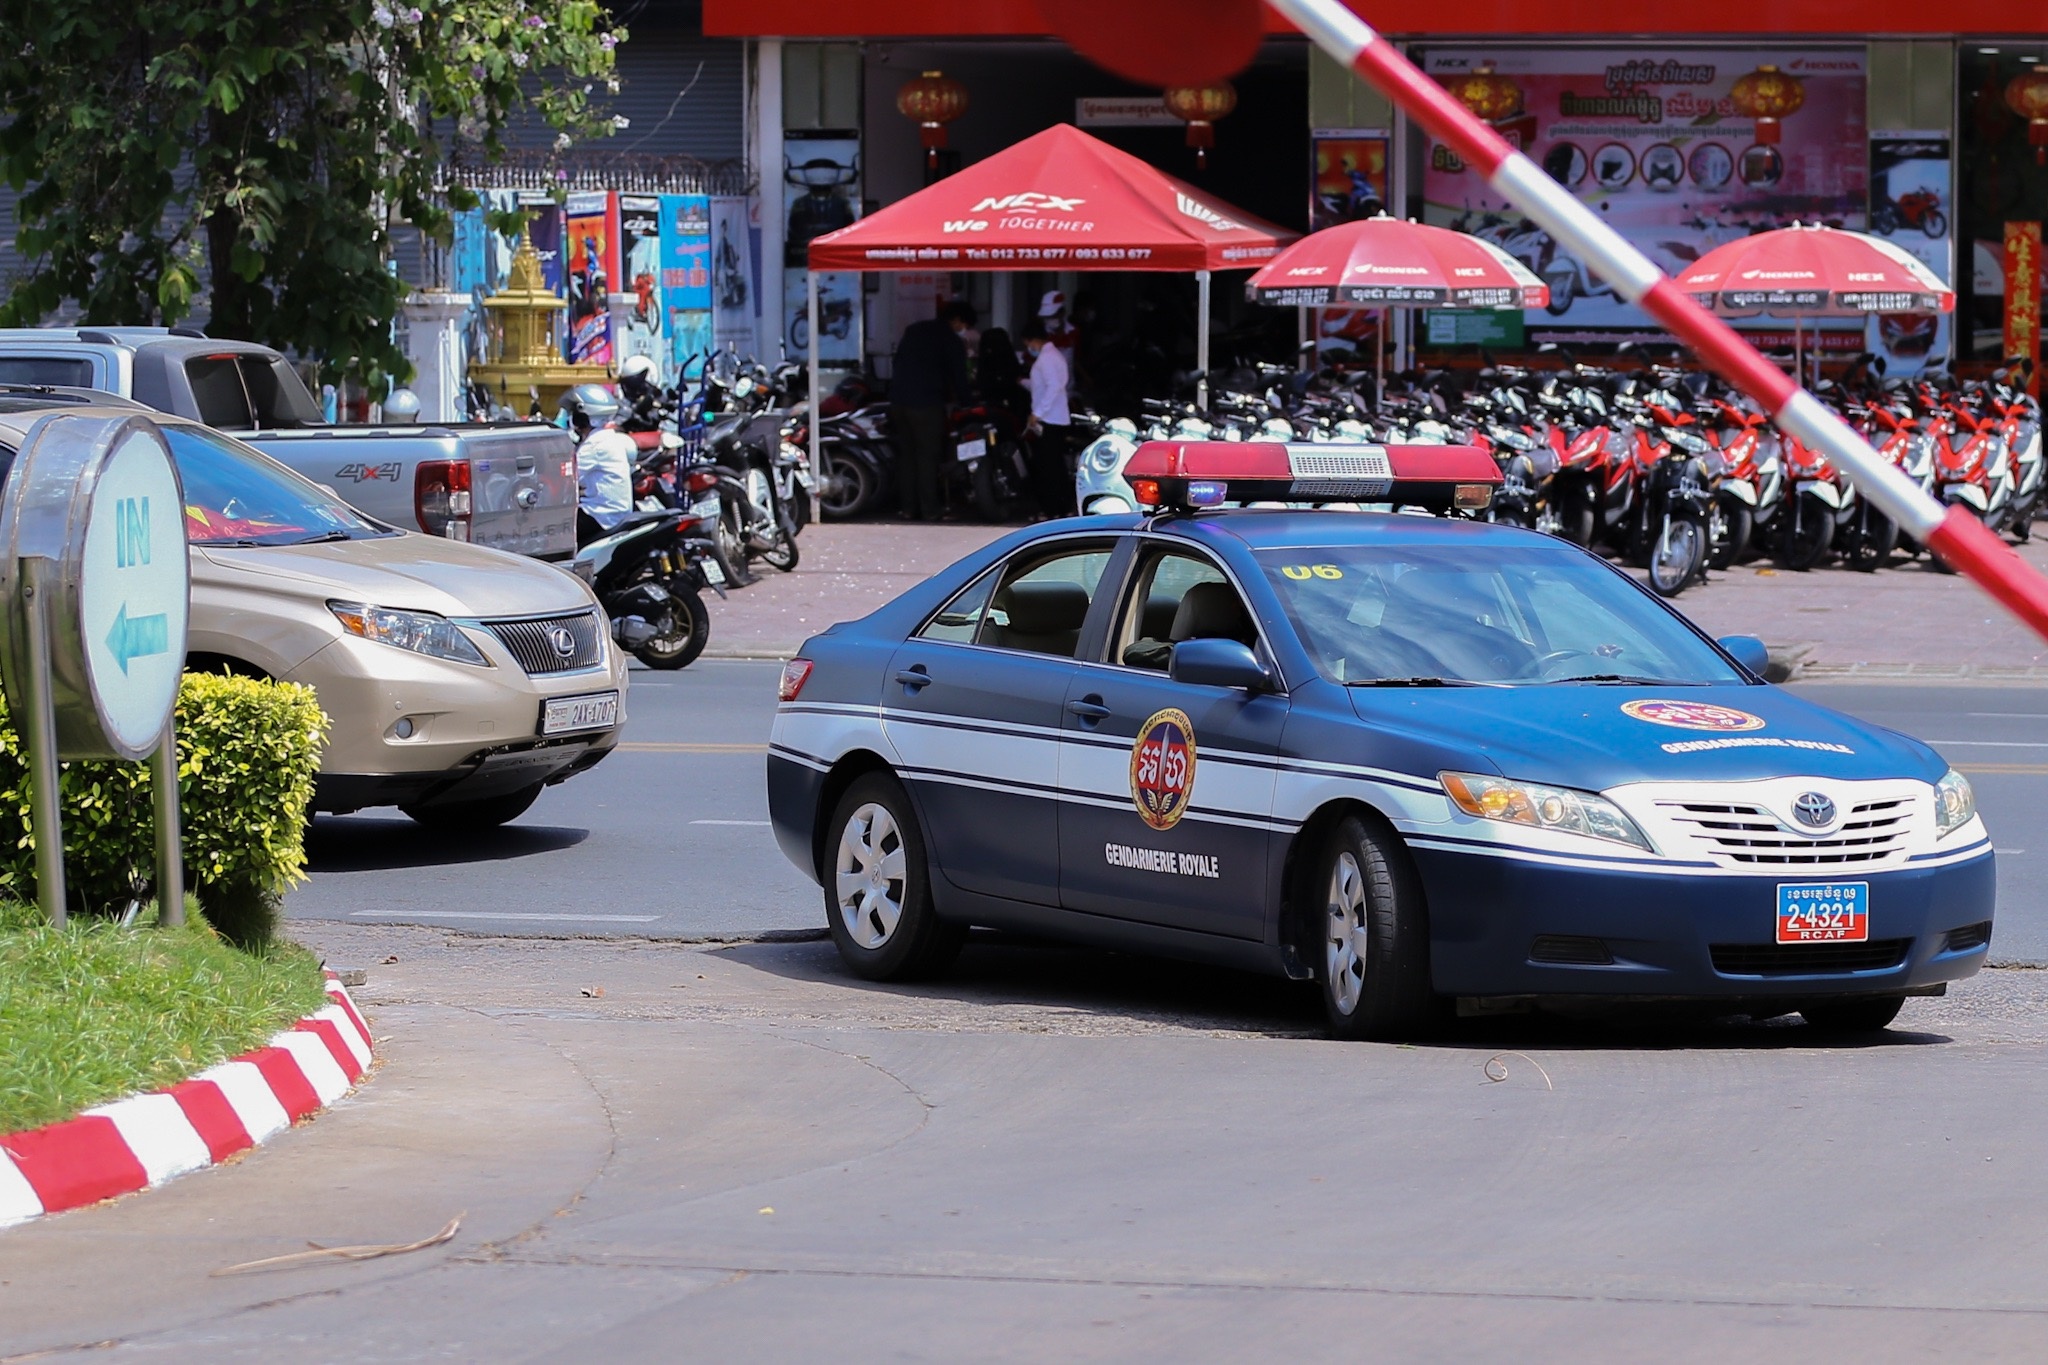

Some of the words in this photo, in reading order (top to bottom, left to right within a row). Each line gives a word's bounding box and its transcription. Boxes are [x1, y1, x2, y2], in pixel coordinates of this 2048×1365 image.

[943, 219, 989, 233] We
[999, 217, 1095, 232] TOGETHER
[991, 249, 1014, 259] 012
[1017, 249, 1040, 259] 733
[1043, 249, 1066, 259] 677
[1075, 249, 1099, 259] 093
[1127, 249, 1151, 259] 677
[116, 496, 151, 568] IN
[476, 522, 571, 543] RANGER
[1661, 737, 1789, 753] GENDARMERIE
[1786, 739, 1855, 754] ROYALE
[1105, 842, 1178, 874] GENDARMERIE
[1178, 852, 1220, 879] ROYALE
[1787, 902, 1854, 929] 2-4321
[1800, 930, 1845, 940] RCAF
